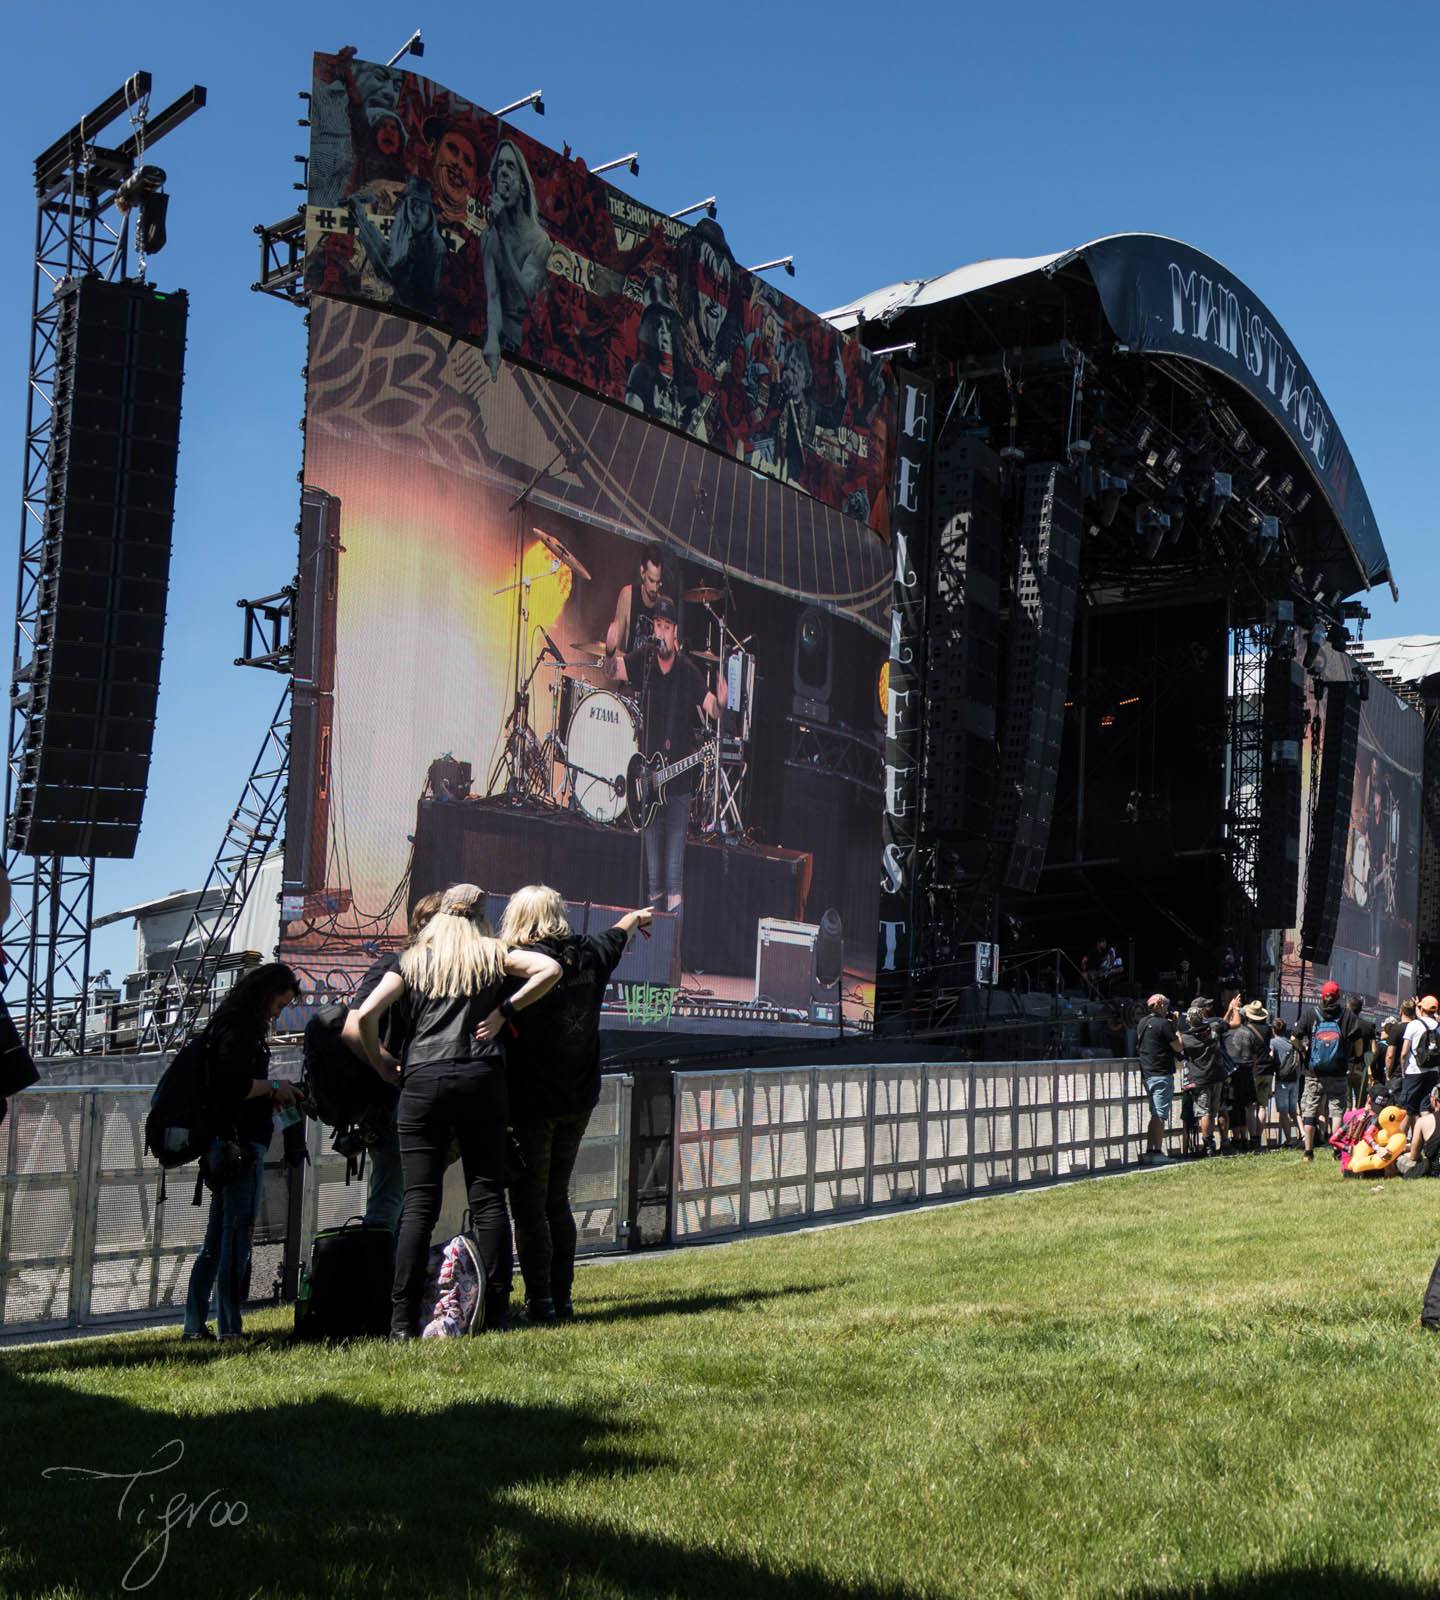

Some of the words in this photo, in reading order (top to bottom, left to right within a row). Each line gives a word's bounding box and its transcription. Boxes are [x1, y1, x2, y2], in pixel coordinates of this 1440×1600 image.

[609, 197, 626, 218] THE
[1168, 262, 1328, 470] MAINSTAGE
[595, 707, 620, 724] TAMA
[879, 383, 928, 971] HELLFEST
